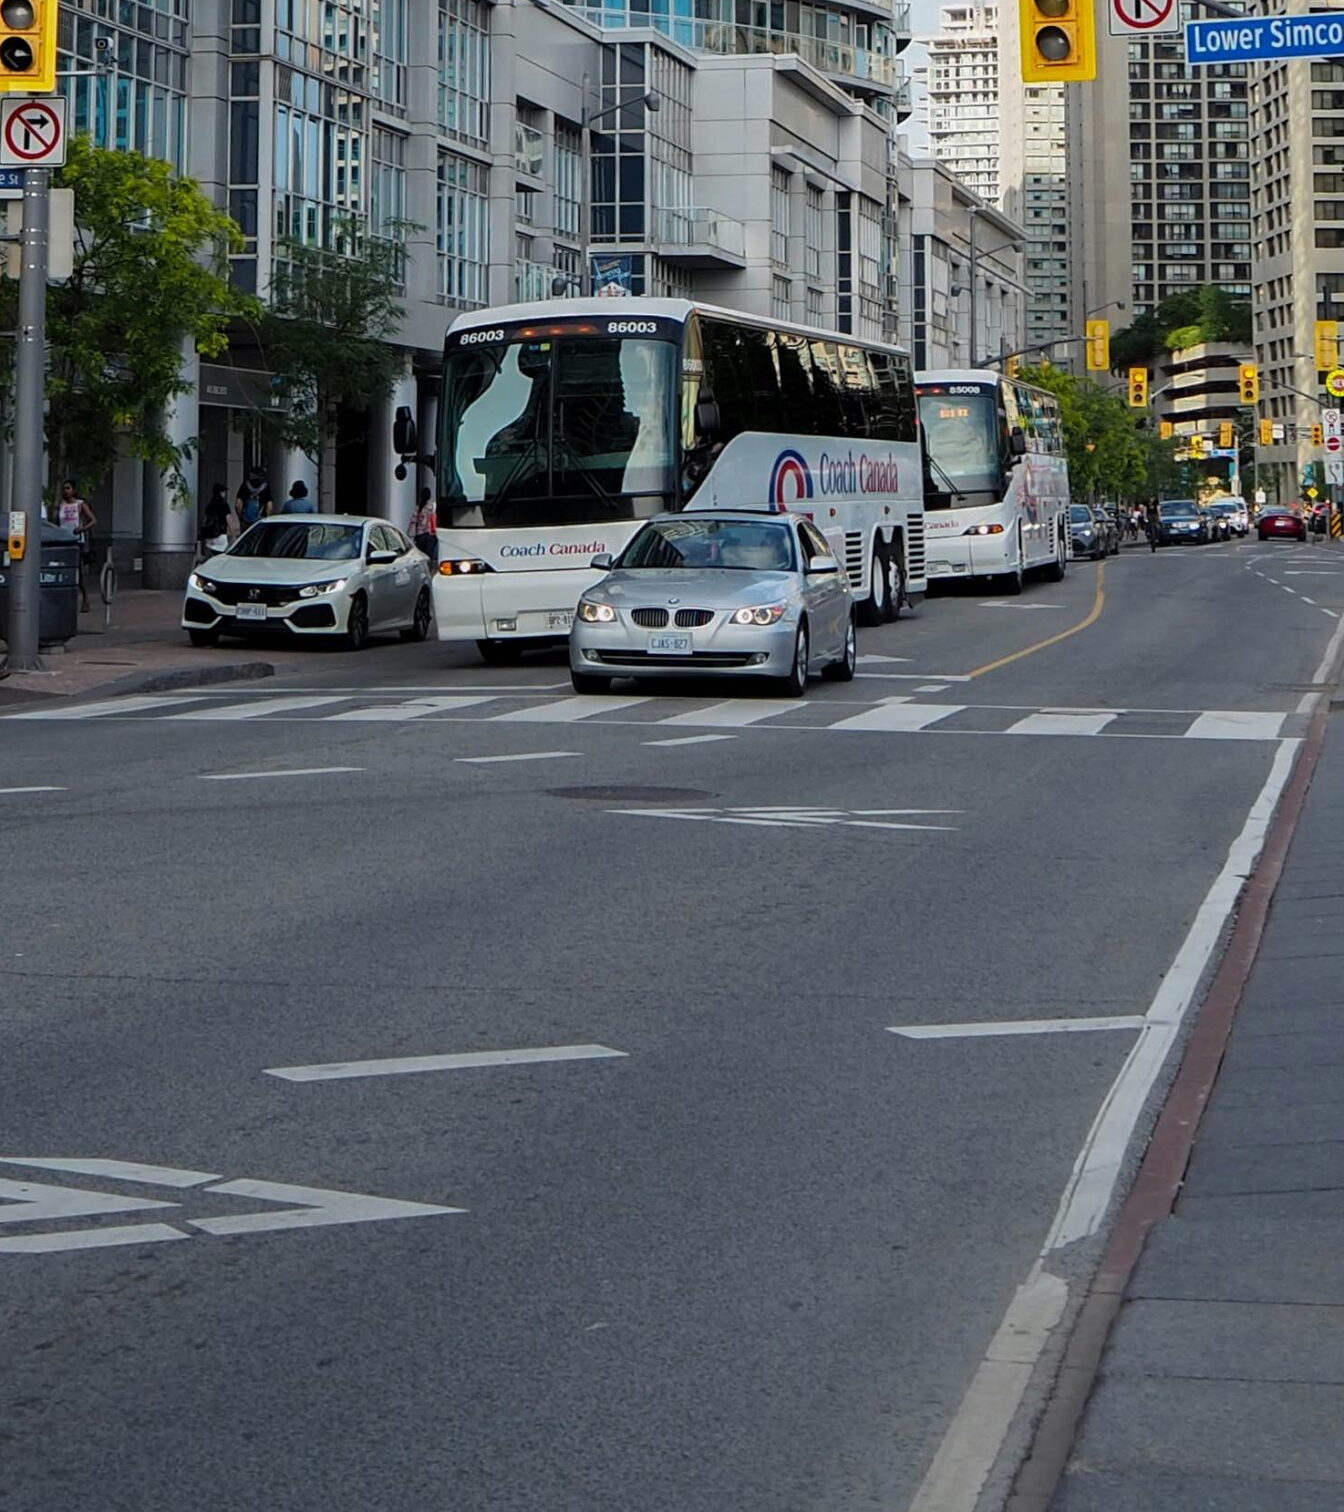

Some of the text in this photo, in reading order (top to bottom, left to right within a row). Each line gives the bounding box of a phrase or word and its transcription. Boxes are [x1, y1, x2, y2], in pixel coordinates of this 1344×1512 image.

[1194, 25, 1263, 53] Lower
[9, 174, 18, 185] St
[608, 322, 657, 334] 86003
[459, 329, 505, 346] 86003
[820, 450, 898, 495] Coach Canada
[500, 541, 606, 557] Coach Canada
